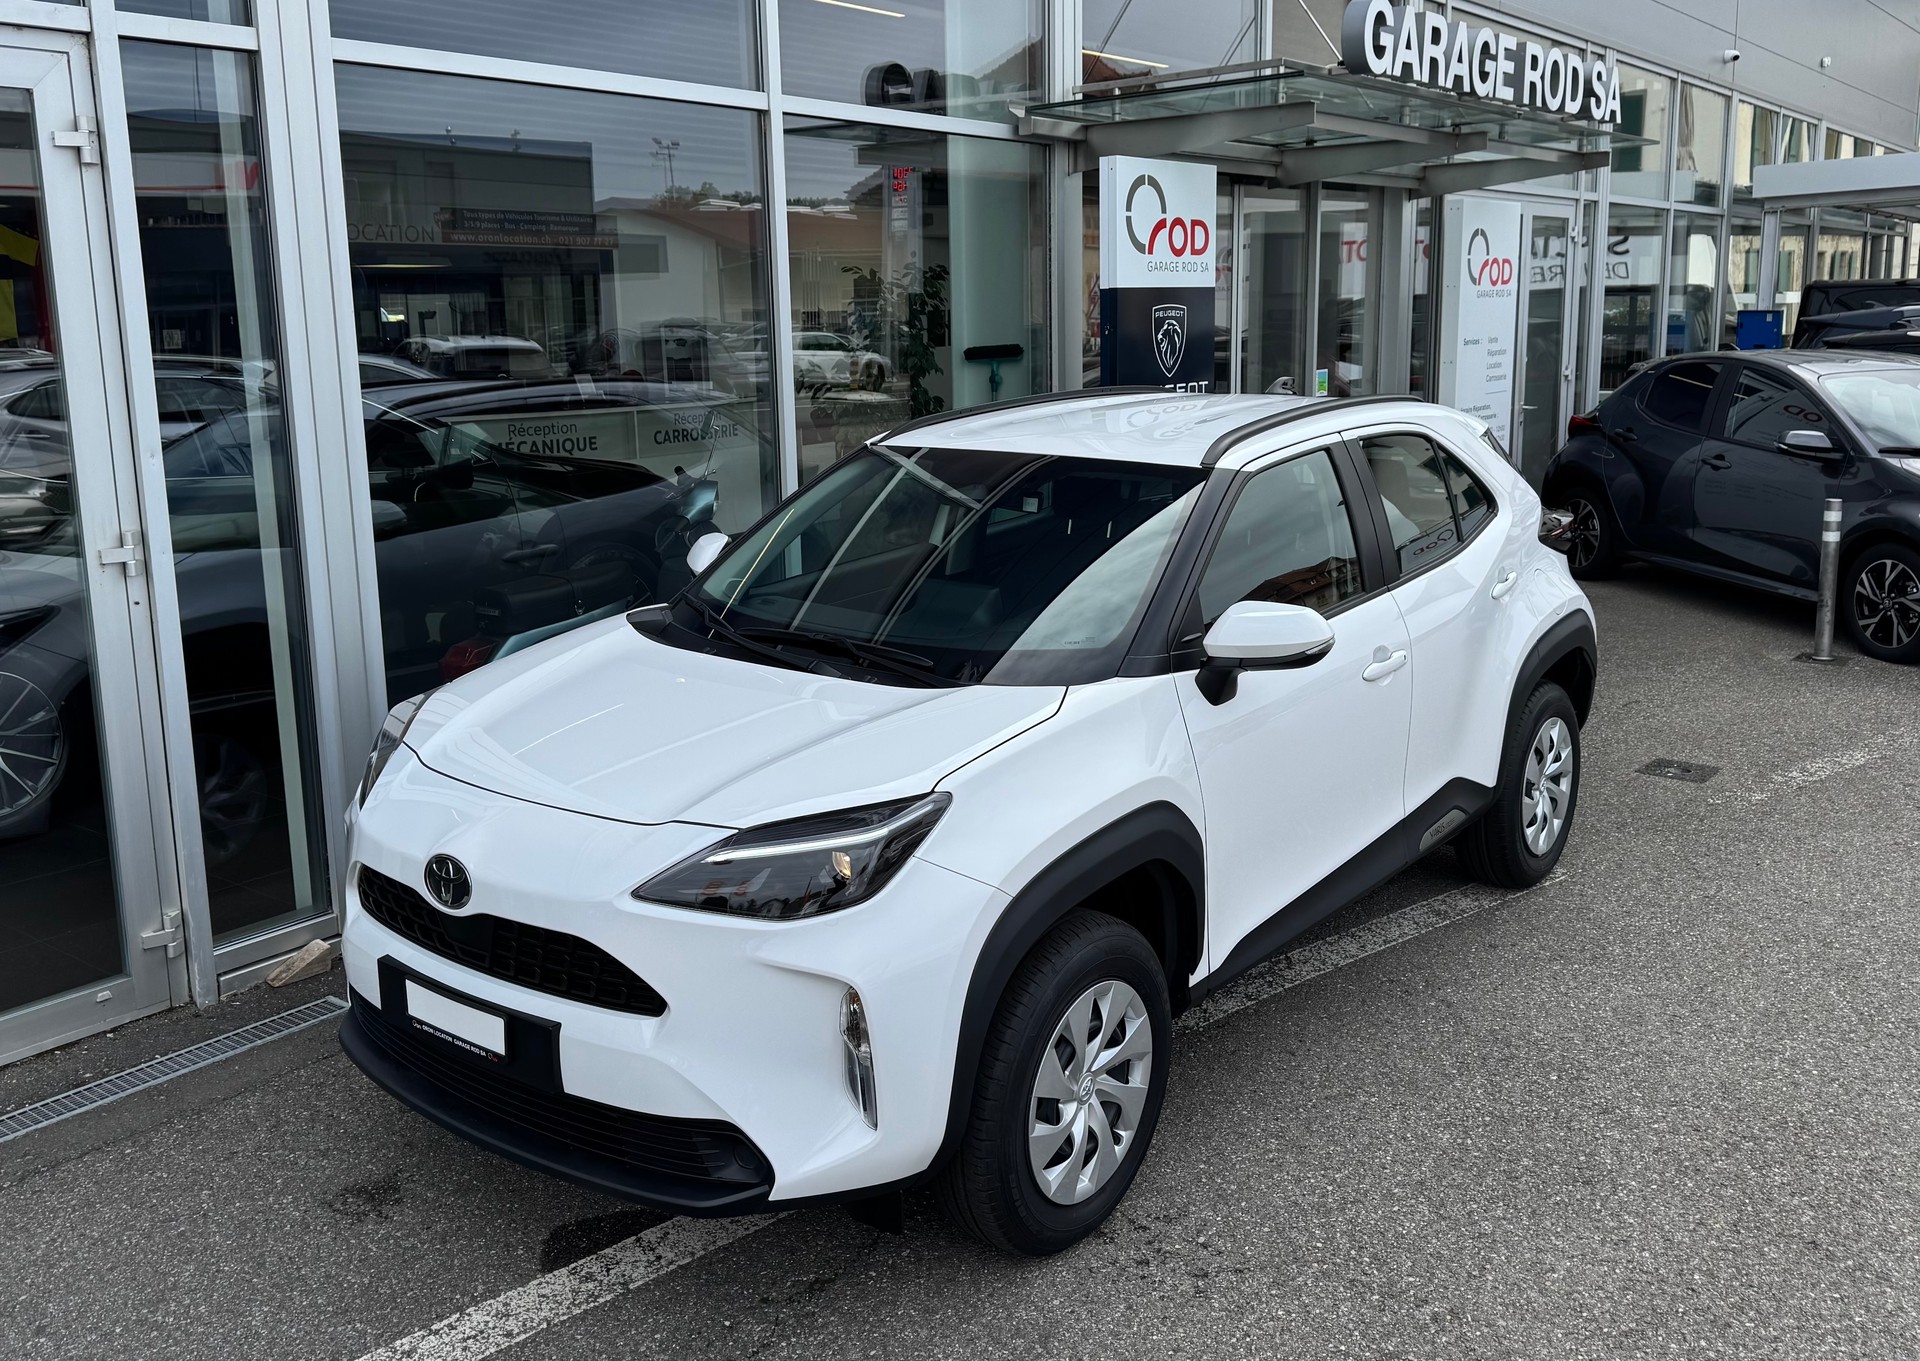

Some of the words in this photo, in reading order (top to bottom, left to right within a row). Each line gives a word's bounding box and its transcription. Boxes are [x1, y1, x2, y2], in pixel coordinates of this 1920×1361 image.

[1364, 0, 1517, 101] GARAGE
[1523, 41, 1584, 114] ROD
[1590, 61, 1621, 124] SA
[478, 211, 496, 220] types
[520, 222, 545, 231] Camping
[450, 233, 551, 244] www.oronlocation.ch
[558, 235, 573, 245] 021
[576, 236, 590, 246] 907
[1147, 261, 1180, 273] GARAGE
[1182, 261, 1198, 273] ROD
[1200, 262, 1210, 273] SA
[1476, 289, 1495, 299] GARAGE
[1155, 310, 1184, 318] PEUGEOT
[674, 411, 721, 426] Récepn
[508, 421, 578, 439] Réception
[497, 436, 598, 456] ÉCANIQUE
[433, 1029, 453, 1043] LOCATION
[453, 1038, 470, 1051] GARAGE
